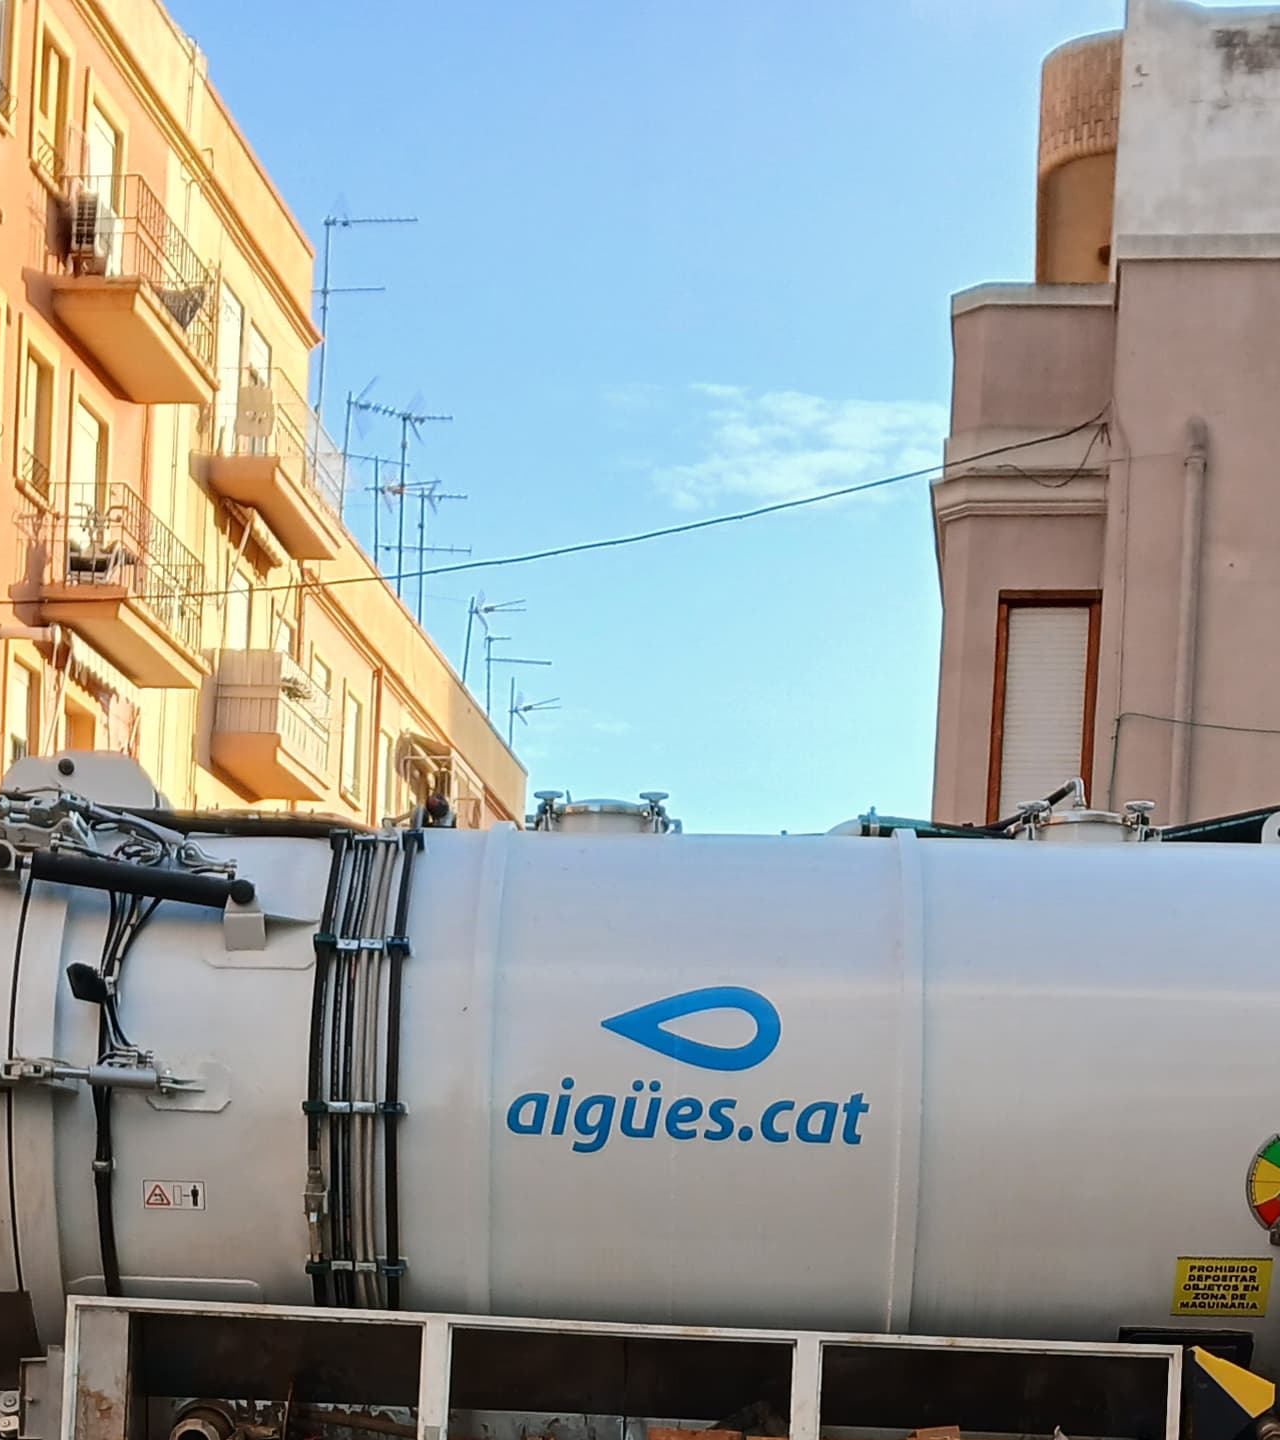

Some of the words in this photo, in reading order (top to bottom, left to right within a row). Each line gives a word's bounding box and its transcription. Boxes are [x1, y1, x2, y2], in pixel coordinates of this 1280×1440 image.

[506, 1077, 870, 1154] aigües.cat
[1189, 1265, 1258, 1273] PROHIBIDO
[1188, 1274, 1257, 1283] DEPOSITAR
[1183, 1283, 1239, 1292] OBJETOS
[1242, 1284, 1260, 1292] EN
[1192, 1292, 1227, 1301] ZONA
[1230, 1293, 1247, 1301] DE
[1179, 1301, 1258, 1310] MAQUINARIA
